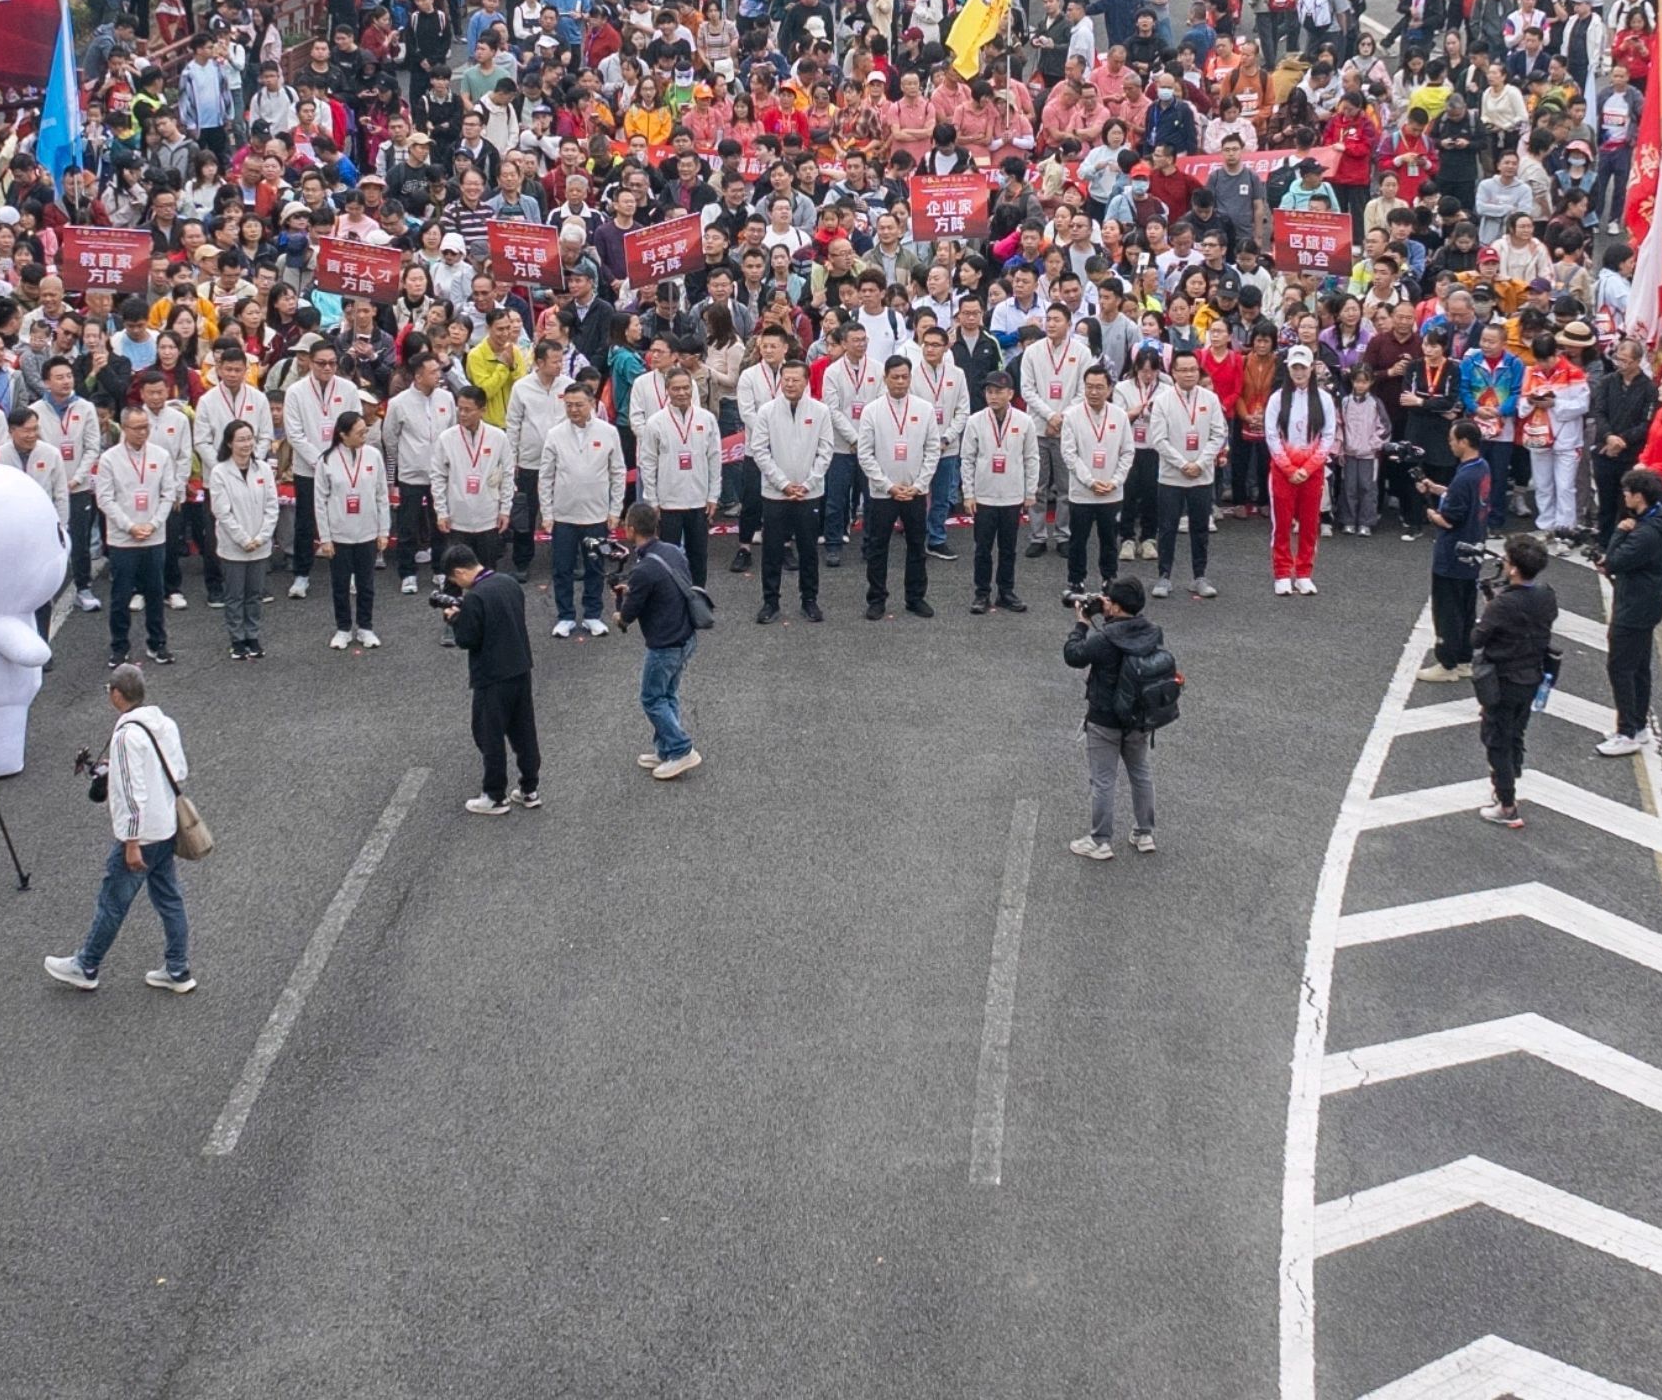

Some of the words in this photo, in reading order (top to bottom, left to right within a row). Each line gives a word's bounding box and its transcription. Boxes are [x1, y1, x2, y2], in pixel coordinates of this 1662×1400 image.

[925, 200, 972, 216] 企业家
[934, 217, 965, 234] 方阵
[641, 238, 689, 264] 科学家
[1289, 233, 1336, 251] 区旅游
[79, 251, 132, 270] 教育家
[503, 243, 547, 263] 老干部
[1298, 250, 1329, 268] 协会
[326, 259, 391, 282] 青年人才
[512, 261, 542, 278] 方阵
[650, 254, 682, 276] 方阵
[87, 268, 124, 285] 方阵
[342, 277, 375, 294] 方阵
